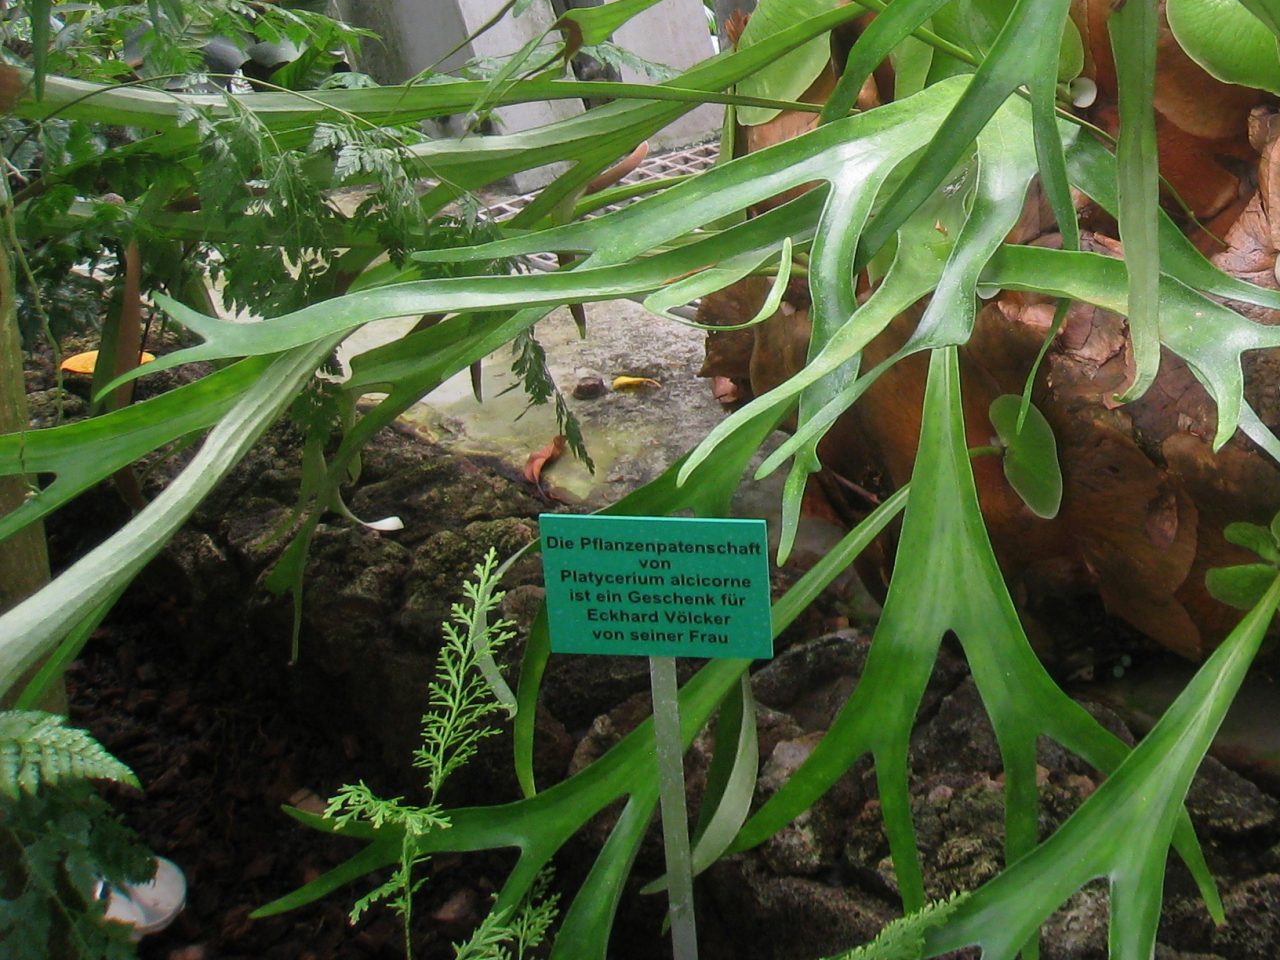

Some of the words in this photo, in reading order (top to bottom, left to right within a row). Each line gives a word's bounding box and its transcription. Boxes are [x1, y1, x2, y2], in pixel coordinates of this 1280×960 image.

[546, 536, 574, 550] Die
[580, 537, 762, 556] Pflanzenpatenschaft
[639, 559, 671, 570] von
[560, 570, 665, 587] Platycerium
[671, 575, 752, 588] alcicorne
[569, 589, 590, 602] ist
[596, 590, 622, 603] ein
[628, 591, 716, 606] Geschenk
[721, 593, 746, 607] für
[587, 609, 659, 624] Eckhard
[665, 611, 731, 625] Völcker
[592, 630, 624, 641] von
[630, 630, 684, 643] seiner
[690, 631, 728, 645] Frau
